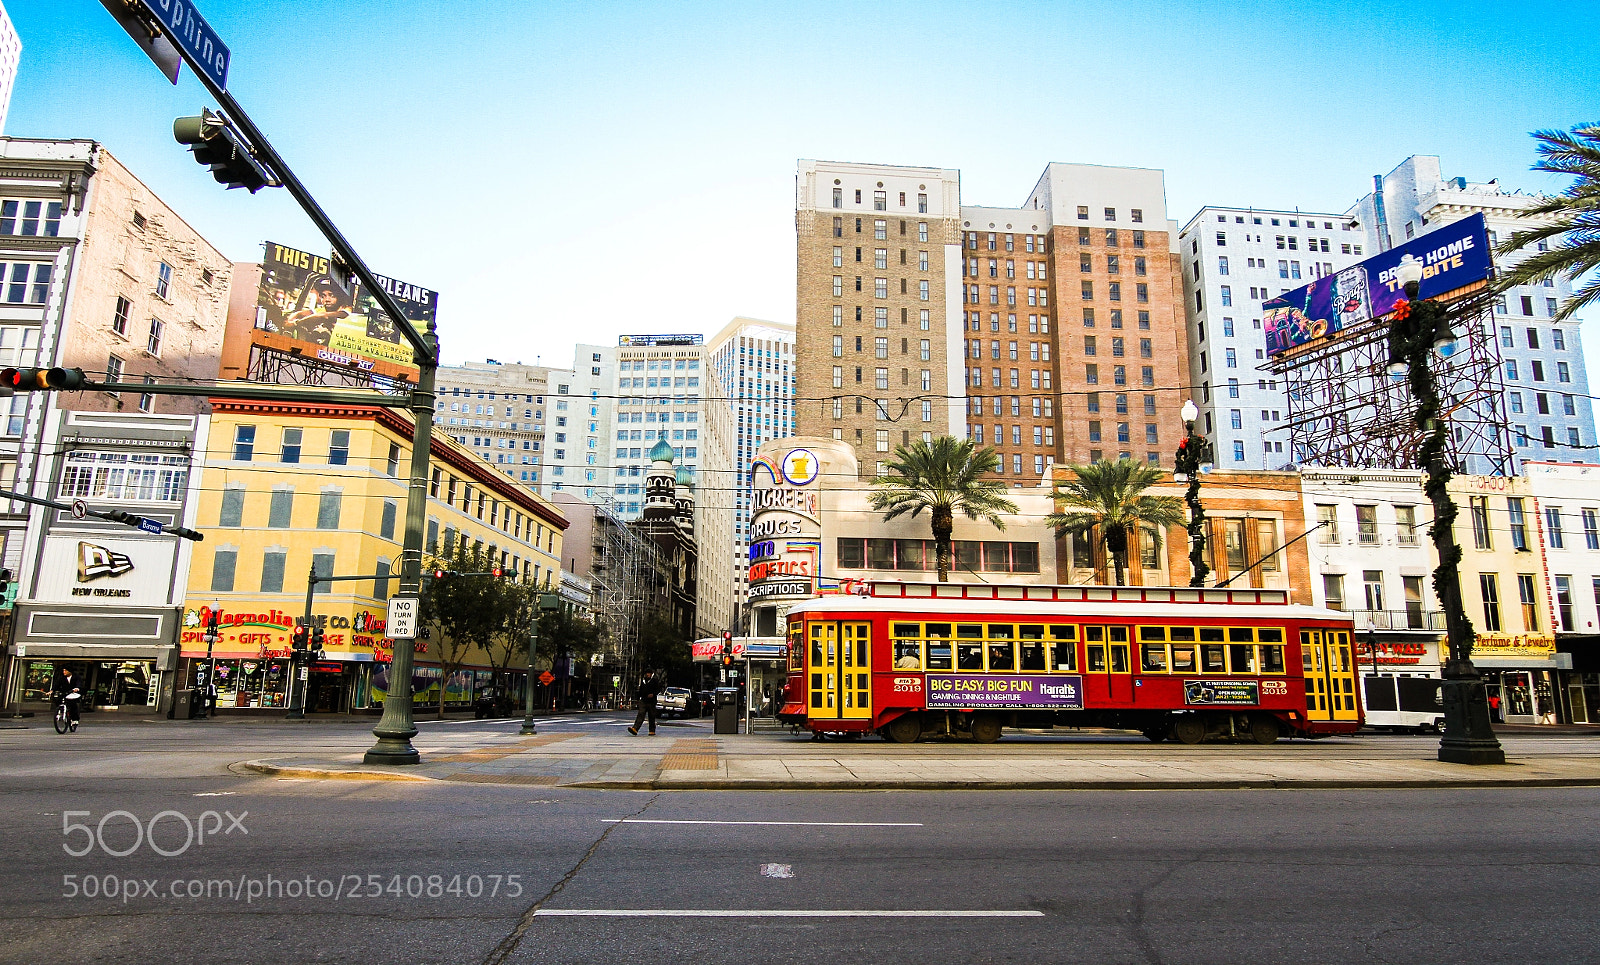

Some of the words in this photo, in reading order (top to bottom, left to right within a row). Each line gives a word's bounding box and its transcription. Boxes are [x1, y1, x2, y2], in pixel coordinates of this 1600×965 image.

[1427, 235, 1475, 265] HOME
[274, 245, 310, 270] THIS
[312, 256, 328, 275] IS
[1422, 253, 1464, 280] BITE
[336, 341, 362, 351] ALBUM
[365, 347, 409, 362] AVAILABLE
[750, 519, 802, 540] DRUGS
[72, 587, 92, 596] NEW
[94, 588, 131, 597] ORLEANS
[396, 602, 411, 610] NO
[200, 606, 293, 627] Magnolia
[296, 615, 327, 628] WNE
[330, 616, 350, 629] CO.
[394, 627, 409, 635] RED
[239, 633, 271, 644] GIFTS
[1476, 633, 1510, 647] Perfume
[1513, 635, 1520, 647] &
[1522, 634, 1555, 649] Jewelry
[1392, 643, 1427, 654] WALL
[893, 684, 922, 692] 2019
[931, 679, 953, 691] BIG
[987, 680, 1008, 692] BIG
[1010, 680, 1032, 692] FUN
[1040, 683, 1076, 695] Harrah's
[1261, 687, 1288, 695] 2019
[991, 693, 1021, 701] NIGHTLIFE
